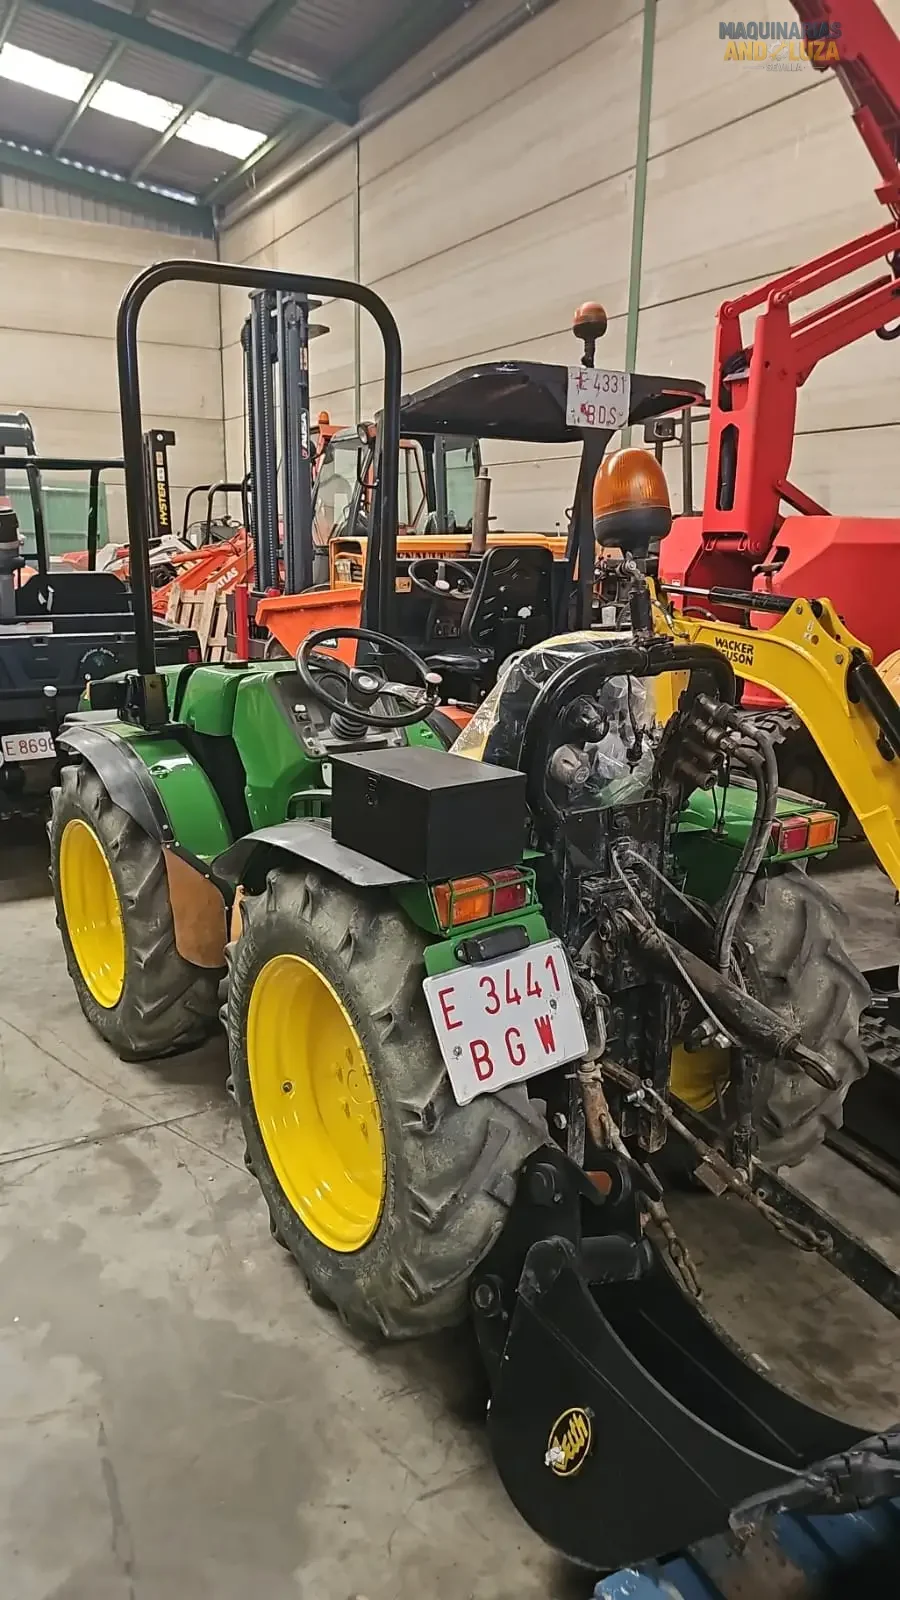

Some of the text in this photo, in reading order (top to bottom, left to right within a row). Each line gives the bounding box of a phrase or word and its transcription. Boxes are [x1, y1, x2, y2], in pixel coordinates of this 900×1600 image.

[594, 373, 625, 395] 4331
[157, 482, 169, 526] HYSTER
[714, 636, 754, 655] WACKER
[5, 740, 17, 756] E
[438, 955, 561, 1031] E 3441
